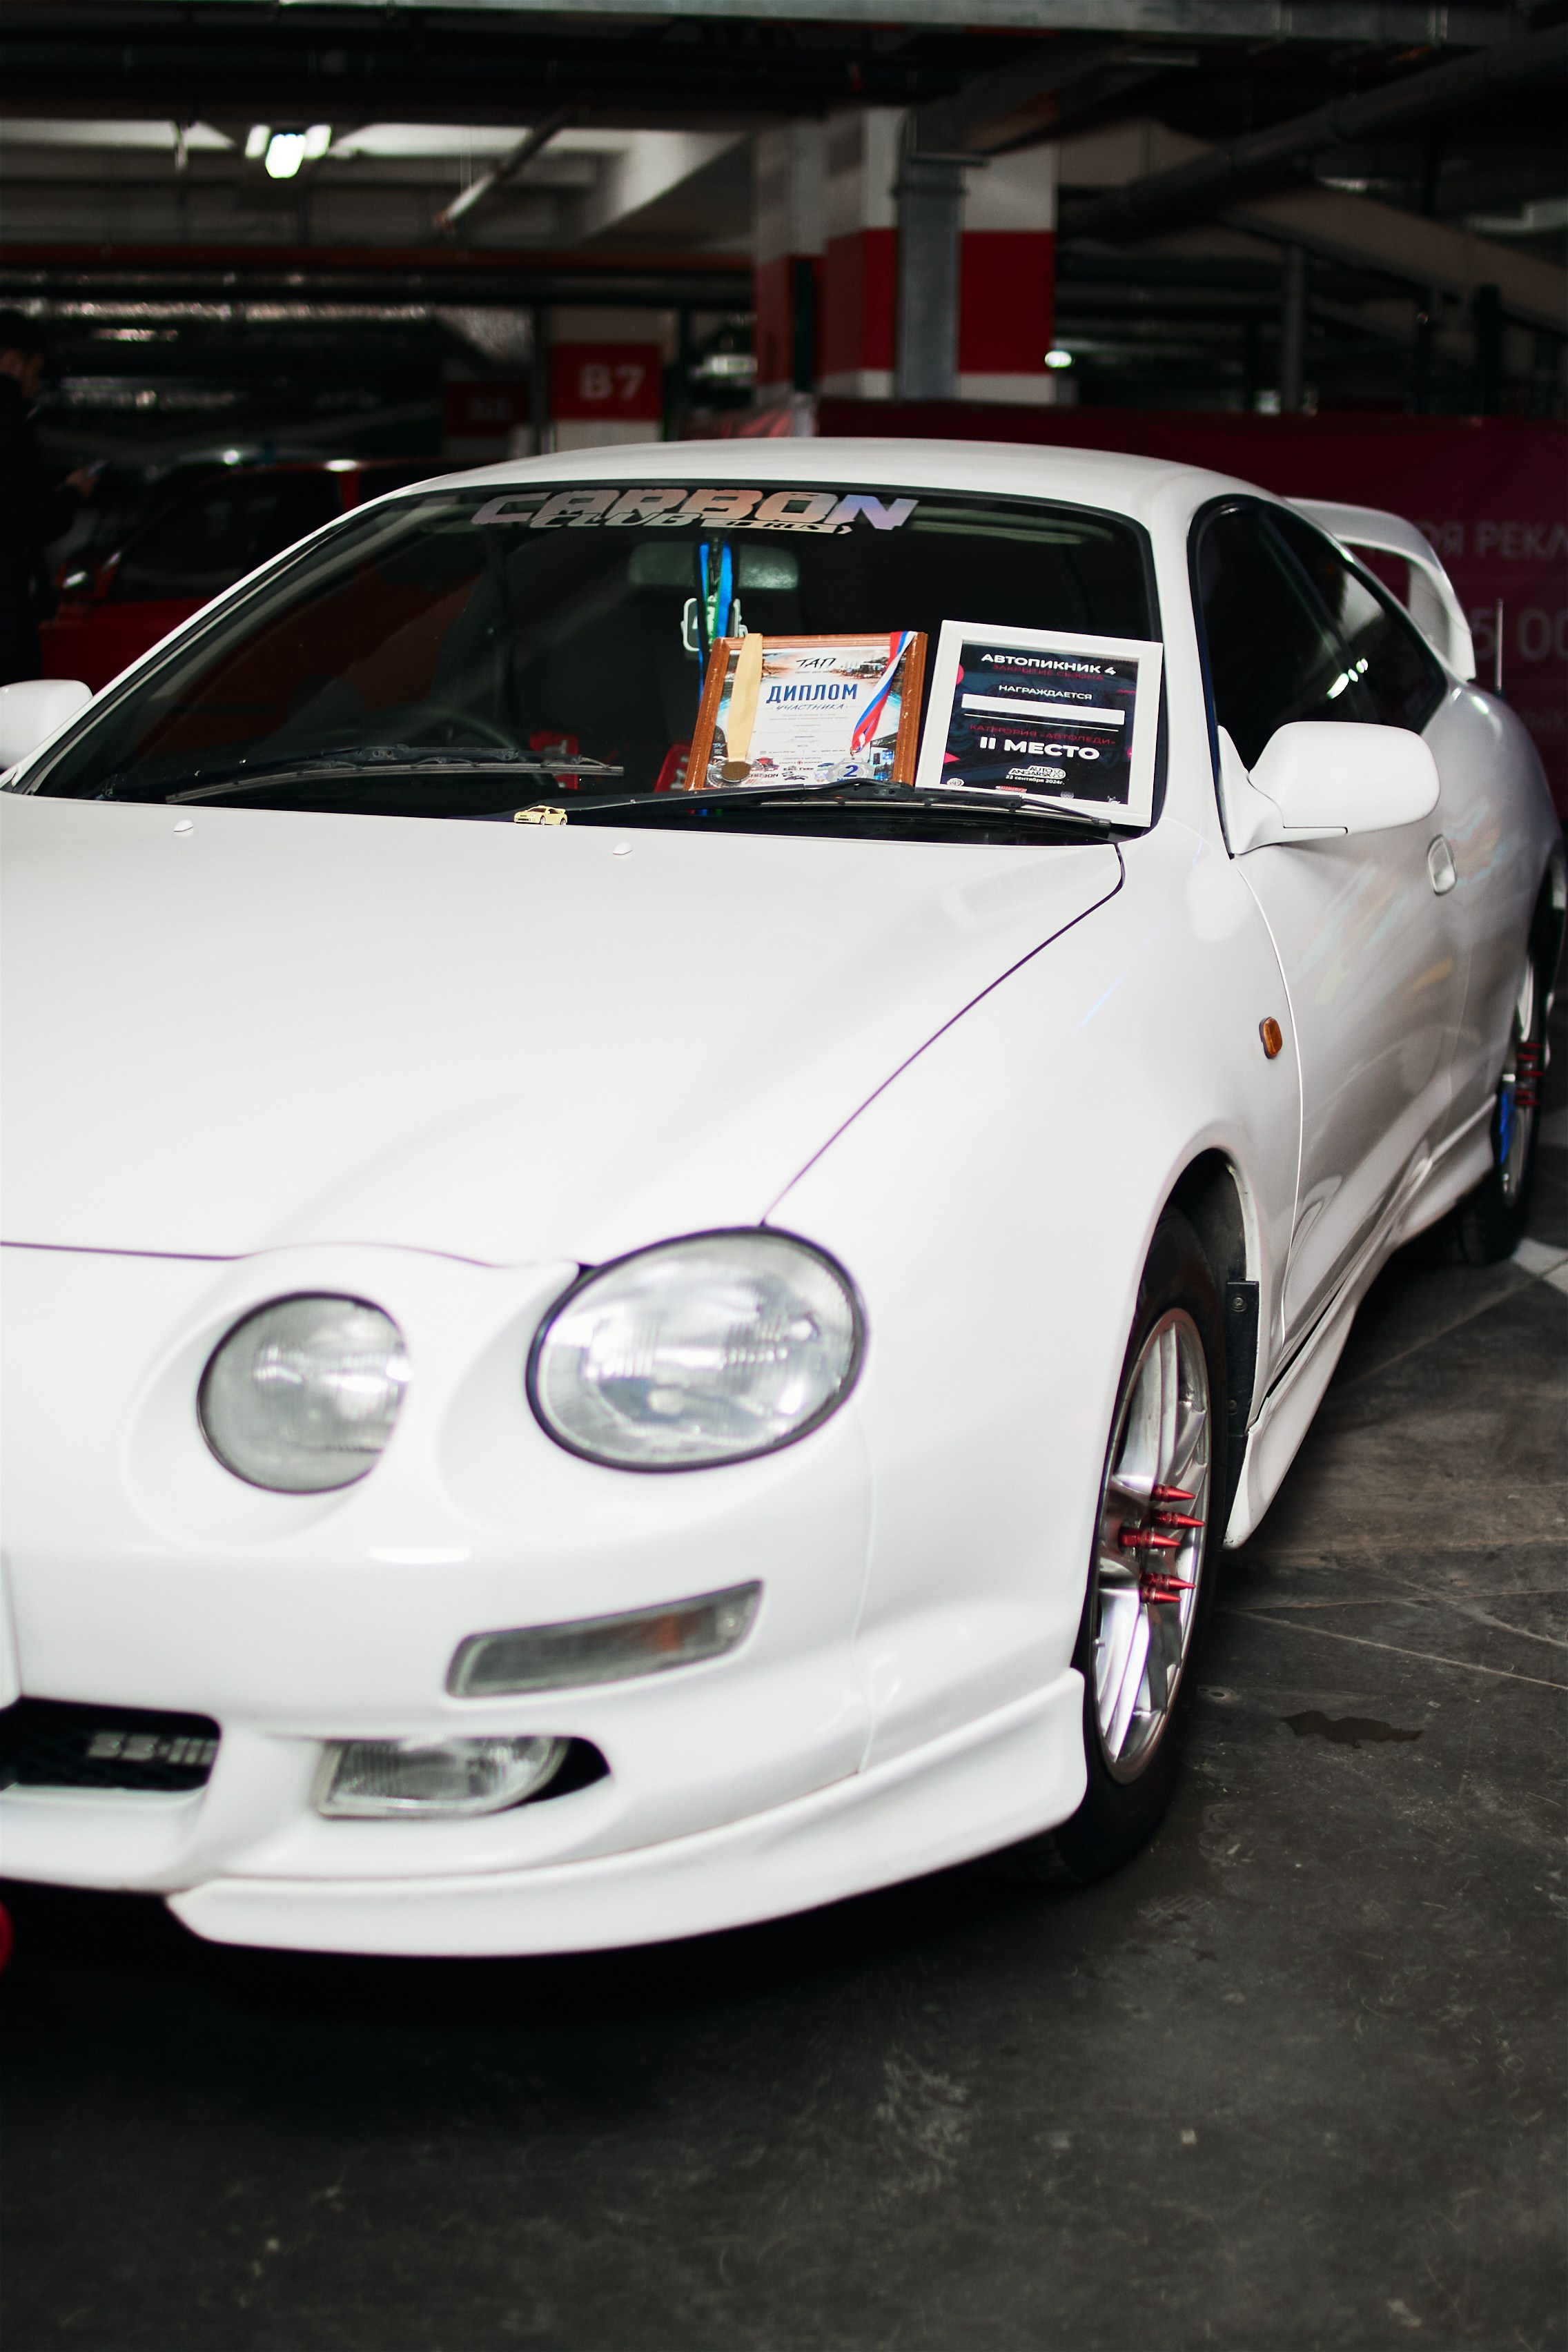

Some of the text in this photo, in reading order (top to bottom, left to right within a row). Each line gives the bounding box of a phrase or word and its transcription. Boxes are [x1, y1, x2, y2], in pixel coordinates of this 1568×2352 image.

[471, 489, 919, 530] CARBON
[529, 511, 703, 528] CLUB
[796, 658, 836, 669] ТАП
[981, 654, 1117, 676] АВТОПИКНИК 4
[992, 665, 1053, 676] ЗАКРЫТИЕ
[766, 683, 858, 703] ДИПЛОМ
[999, 685, 1092, 700] НАГРАЖДАЕТСЯ
[970, 724, 1037, 738] КАТЕГОРИЯ
[1003, 739, 1100, 760] МЕСТО
[843, 765, 858, 777] 2
